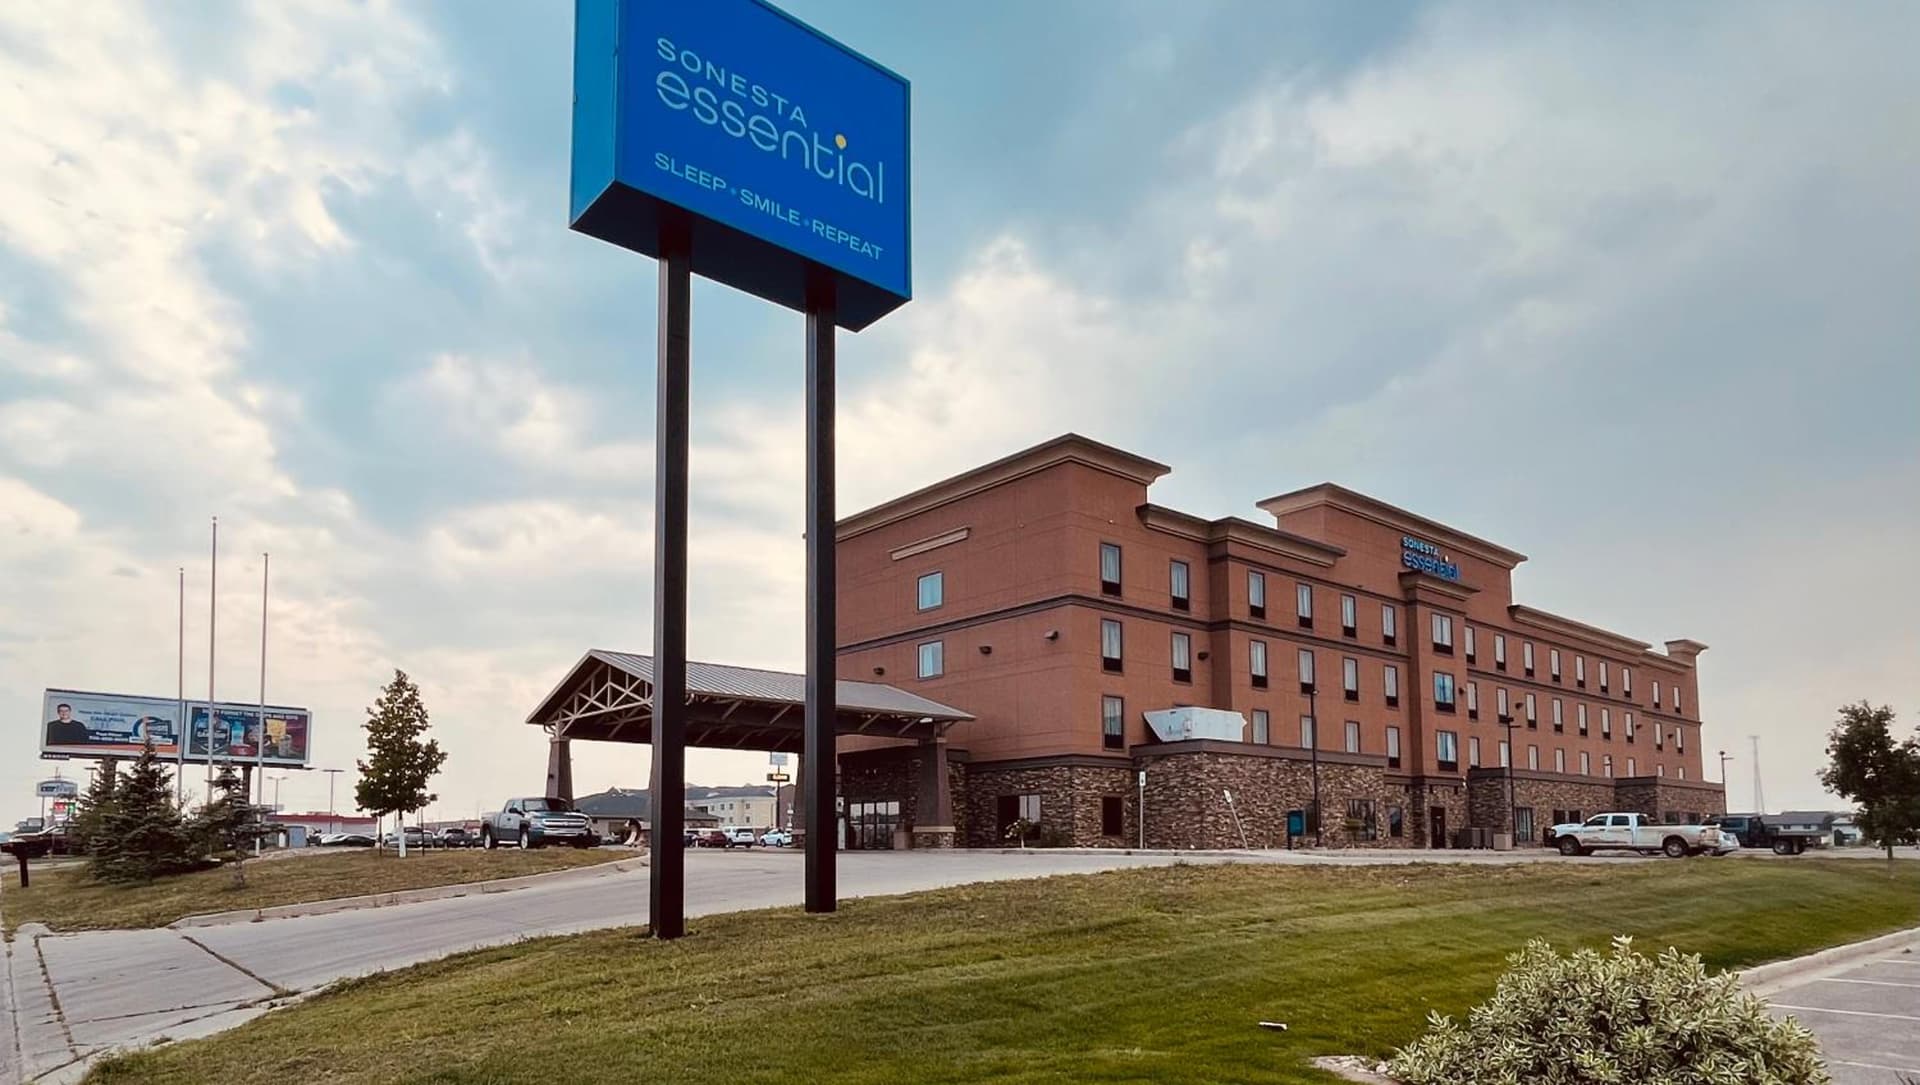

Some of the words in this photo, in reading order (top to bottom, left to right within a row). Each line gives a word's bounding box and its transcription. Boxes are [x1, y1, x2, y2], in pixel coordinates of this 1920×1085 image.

[656, 37, 807, 128] SONESTA
[656, 70, 883, 204] essential
[655, 152, 727, 192] SLEEP
[740, 188, 801, 226] SMILE
[812, 218, 883, 261] REPEAT
[1402, 536, 1439, 556] SONESTA
[1403, 550, 1460, 580] essential
